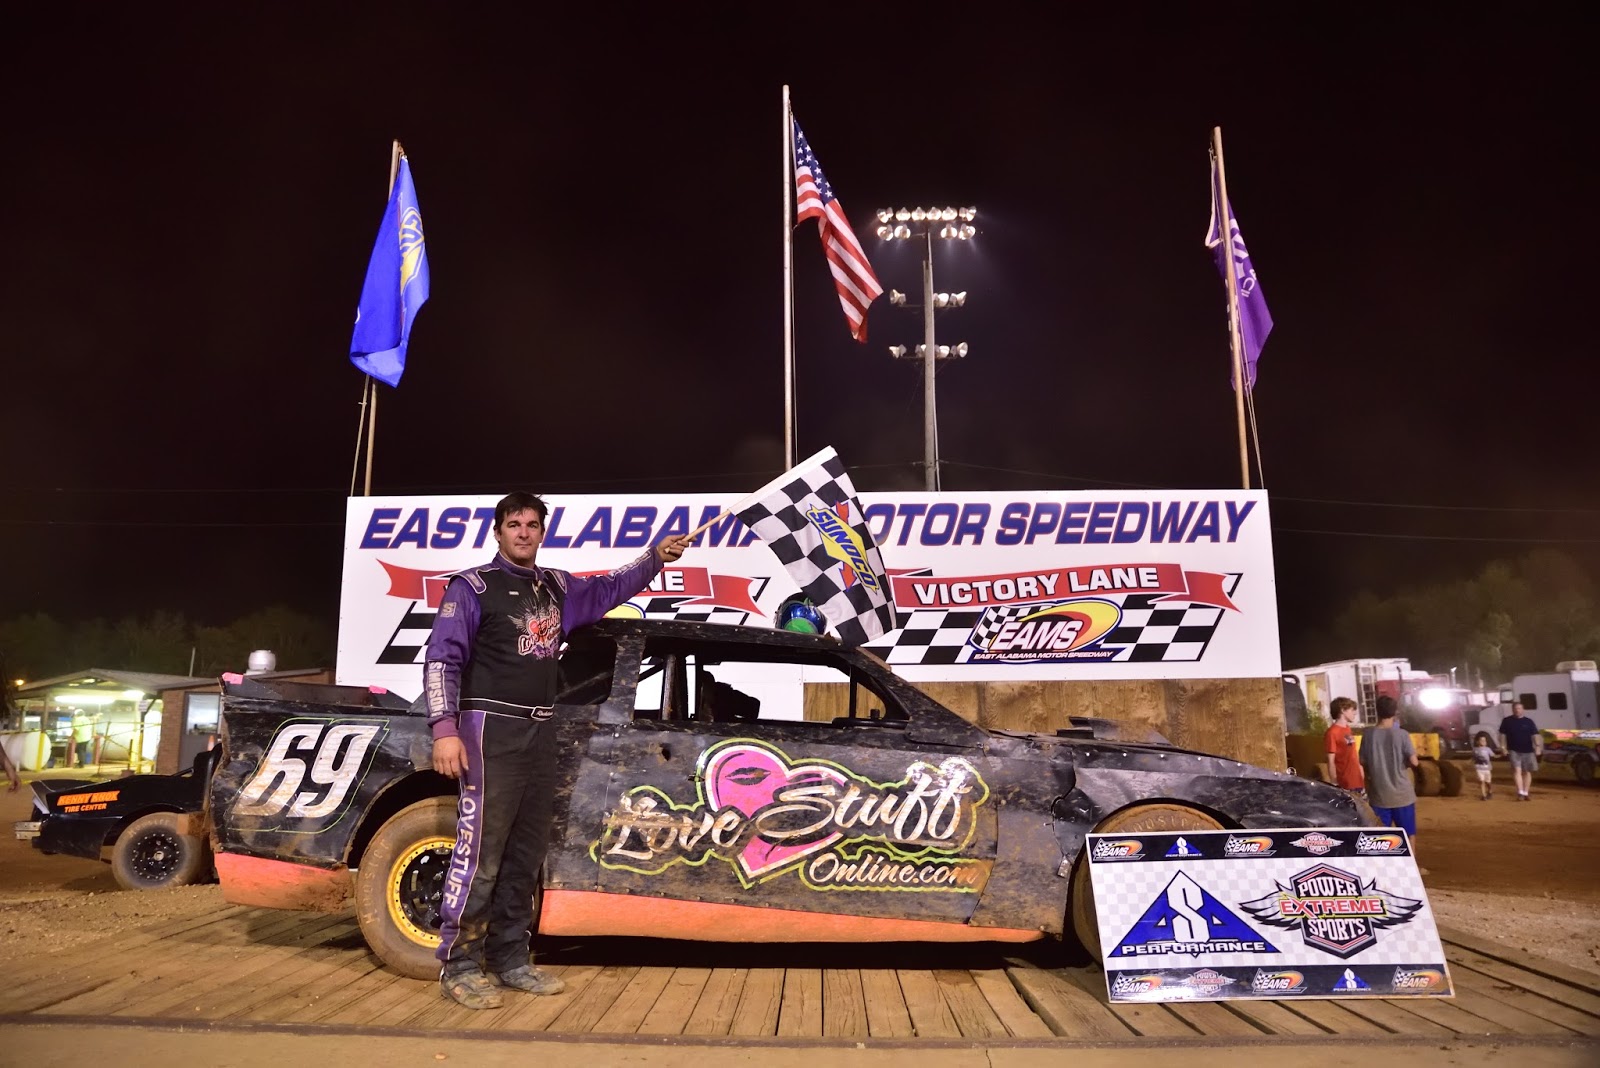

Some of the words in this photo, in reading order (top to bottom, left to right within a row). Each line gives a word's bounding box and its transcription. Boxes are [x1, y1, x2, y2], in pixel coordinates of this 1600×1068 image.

[359, 506, 497, 549] EAST
[540, 505, 763, 548] LABAM
[862, 503, 992, 546] OTOR
[995, 500, 1258, 545] SPEEDWAY
[811, 510, 876, 587] SUNOCO
[914, 573, 1059, 604] VICTORY
[1068, 567, 1159, 592] LANE
[989, 620, 1084, 650] EAMS
[974, 652, 997, 660] EAST
[231, 723, 380, 818] 69
[64, 805, 80, 813] TIRE
[80, 803, 107, 812] CENTER
[607, 794, 745, 860] Love
[755, 763, 973, 841] Stuff
[1101, 845, 1129, 856] EAMS
[1233, 843, 1260, 852] EAMS
[1363, 841, 1391, 851] EAMS
[808, 852, 979, 884] Online.com
[1297, 876, 1359, 897] POWER
[1280, 897, 1383, 918] EXTREME
[1307, 918, 1366, 941] SPORTS
[1121, 942, 1266, 955] PERFORMANCE
[1121, 982, 1150, 993] EAMS
[1261, 979, 1290, 989] EAMS
[1401, 977, 1429, 988] EAMS
